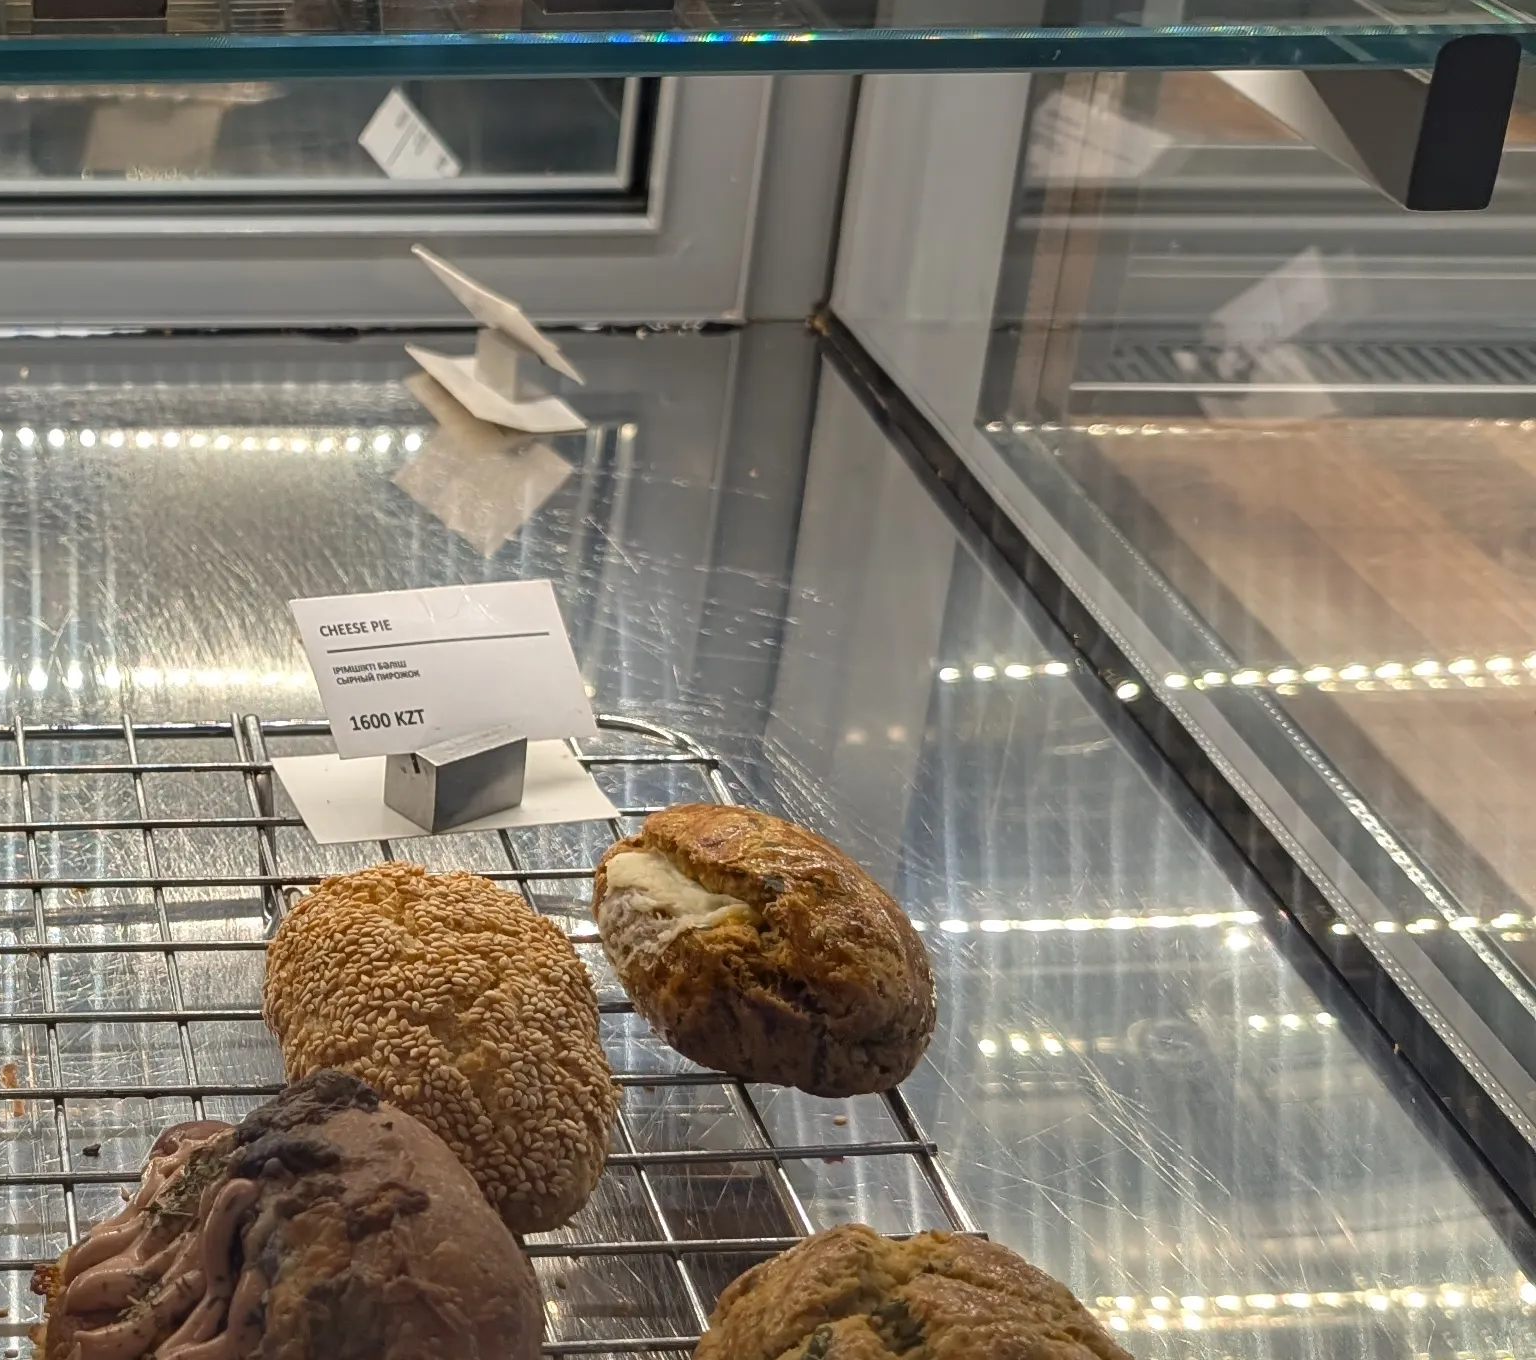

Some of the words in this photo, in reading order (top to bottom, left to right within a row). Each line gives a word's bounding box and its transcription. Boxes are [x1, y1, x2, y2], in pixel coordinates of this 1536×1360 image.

[320, 622, 368, 636] CHEESE
[371, 620, 392, 632] PIE
[336, 673, 375, 685] СЫРНЫЙ
[377, 669, 420, 681] ПИРОЖОК
[350, 713, 391, 731] 1600
[394, 709, 424, 726] KZT
